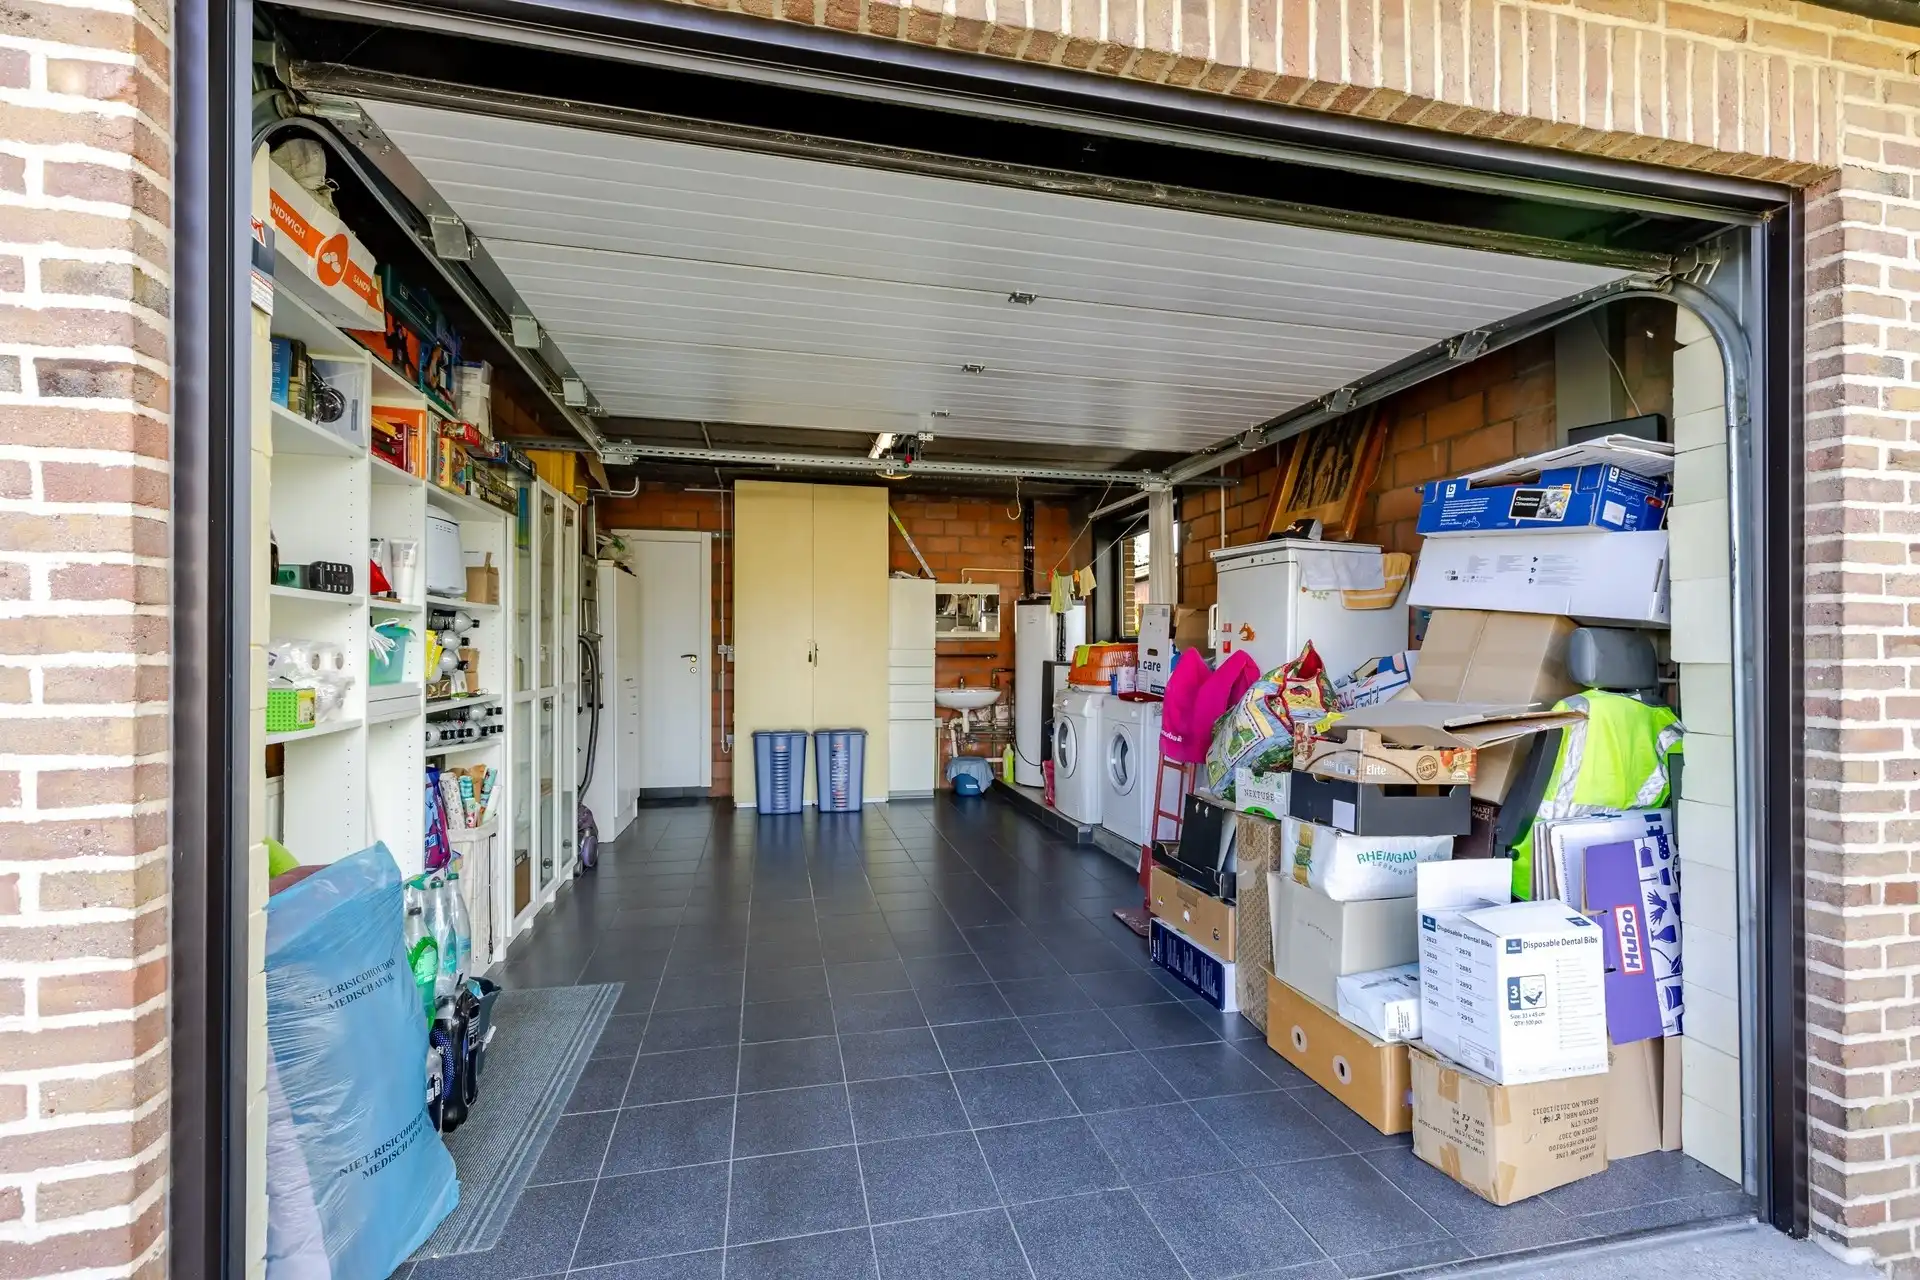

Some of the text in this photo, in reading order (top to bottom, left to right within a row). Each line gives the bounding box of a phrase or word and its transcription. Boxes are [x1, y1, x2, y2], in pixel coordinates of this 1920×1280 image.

[271, 202, 306, 239] NDWICH
[1143, 660, 1161, 672] care
[1366, 764, 1386, 776] Elite
[1356, 850, 1417, 864] RHEINGAU
[1523, 938, 1560, 950] Disposable
[1561, 936, 1583, 946] Dental
[1584, 936, 1598, 944] Bibs
[1622, 908, 1640, 969] Hubo
[1510, 986, 1518, 998] 3
